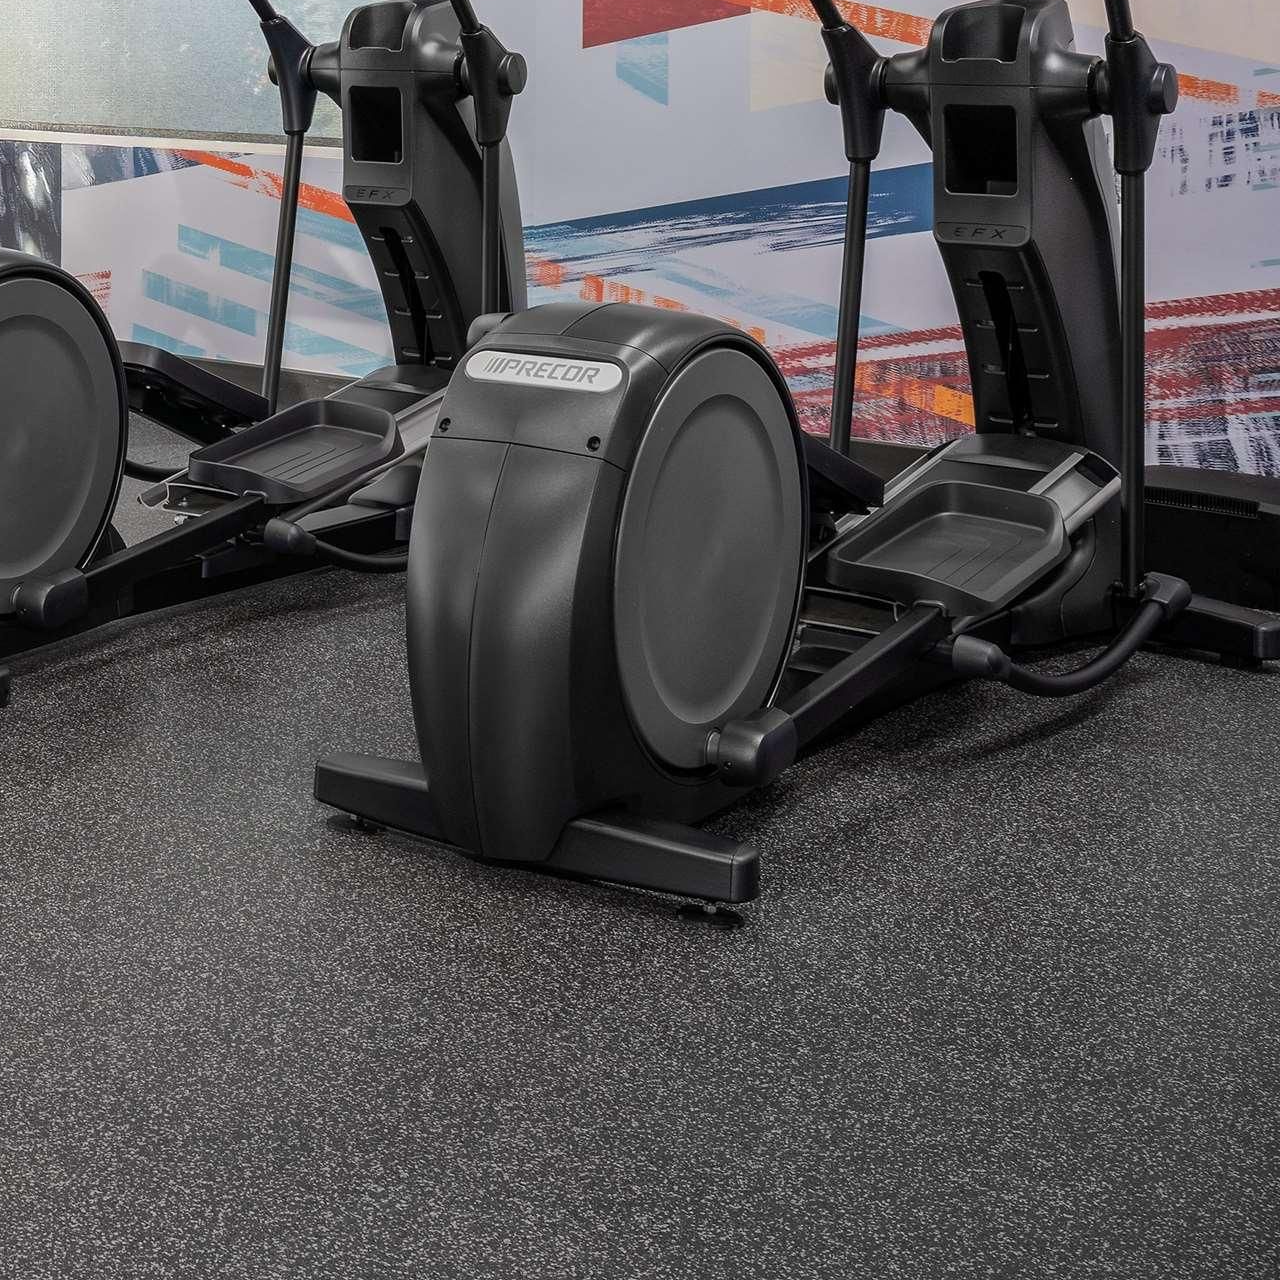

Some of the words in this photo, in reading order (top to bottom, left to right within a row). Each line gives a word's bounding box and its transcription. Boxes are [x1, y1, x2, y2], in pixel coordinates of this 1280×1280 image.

[356, 189, 396, 200] EFX
[953, 226, 1008, 239] EFX
[498, 357, 601, 385] PRECOR
